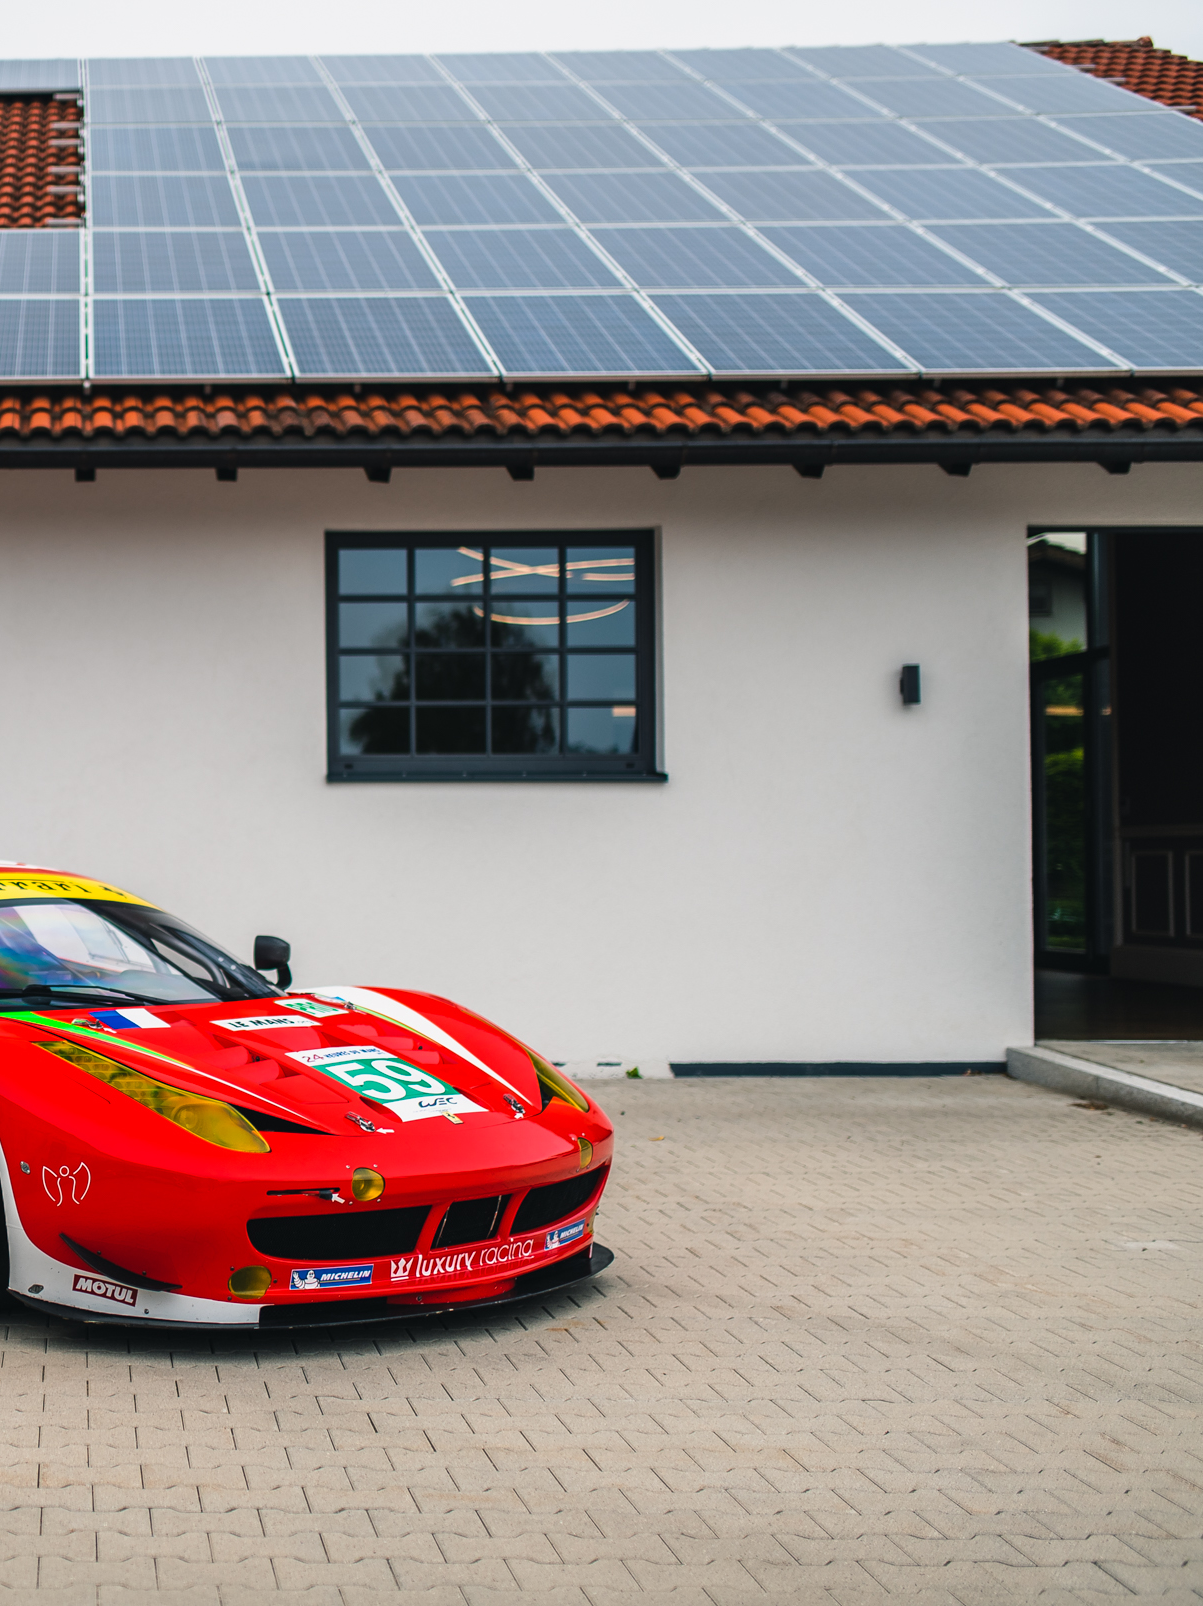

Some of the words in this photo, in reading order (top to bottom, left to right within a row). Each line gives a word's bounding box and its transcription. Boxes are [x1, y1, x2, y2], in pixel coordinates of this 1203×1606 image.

[228, 1020, 249, 1028] LE
[302, 1052, 324, 1062] 24
[325, 1060, 446, 1100] 59
[418, 1097, 457, 1108] WEC
[560, 1224, 584, 1239] MICHELIN
[416, 1251, 476, 1277] luxury
[479, 1237, 535, 1265] racing
[320, 1270, 371, 1281] MICHELIN
[75, 1277, 134, 1304] MOTUL
